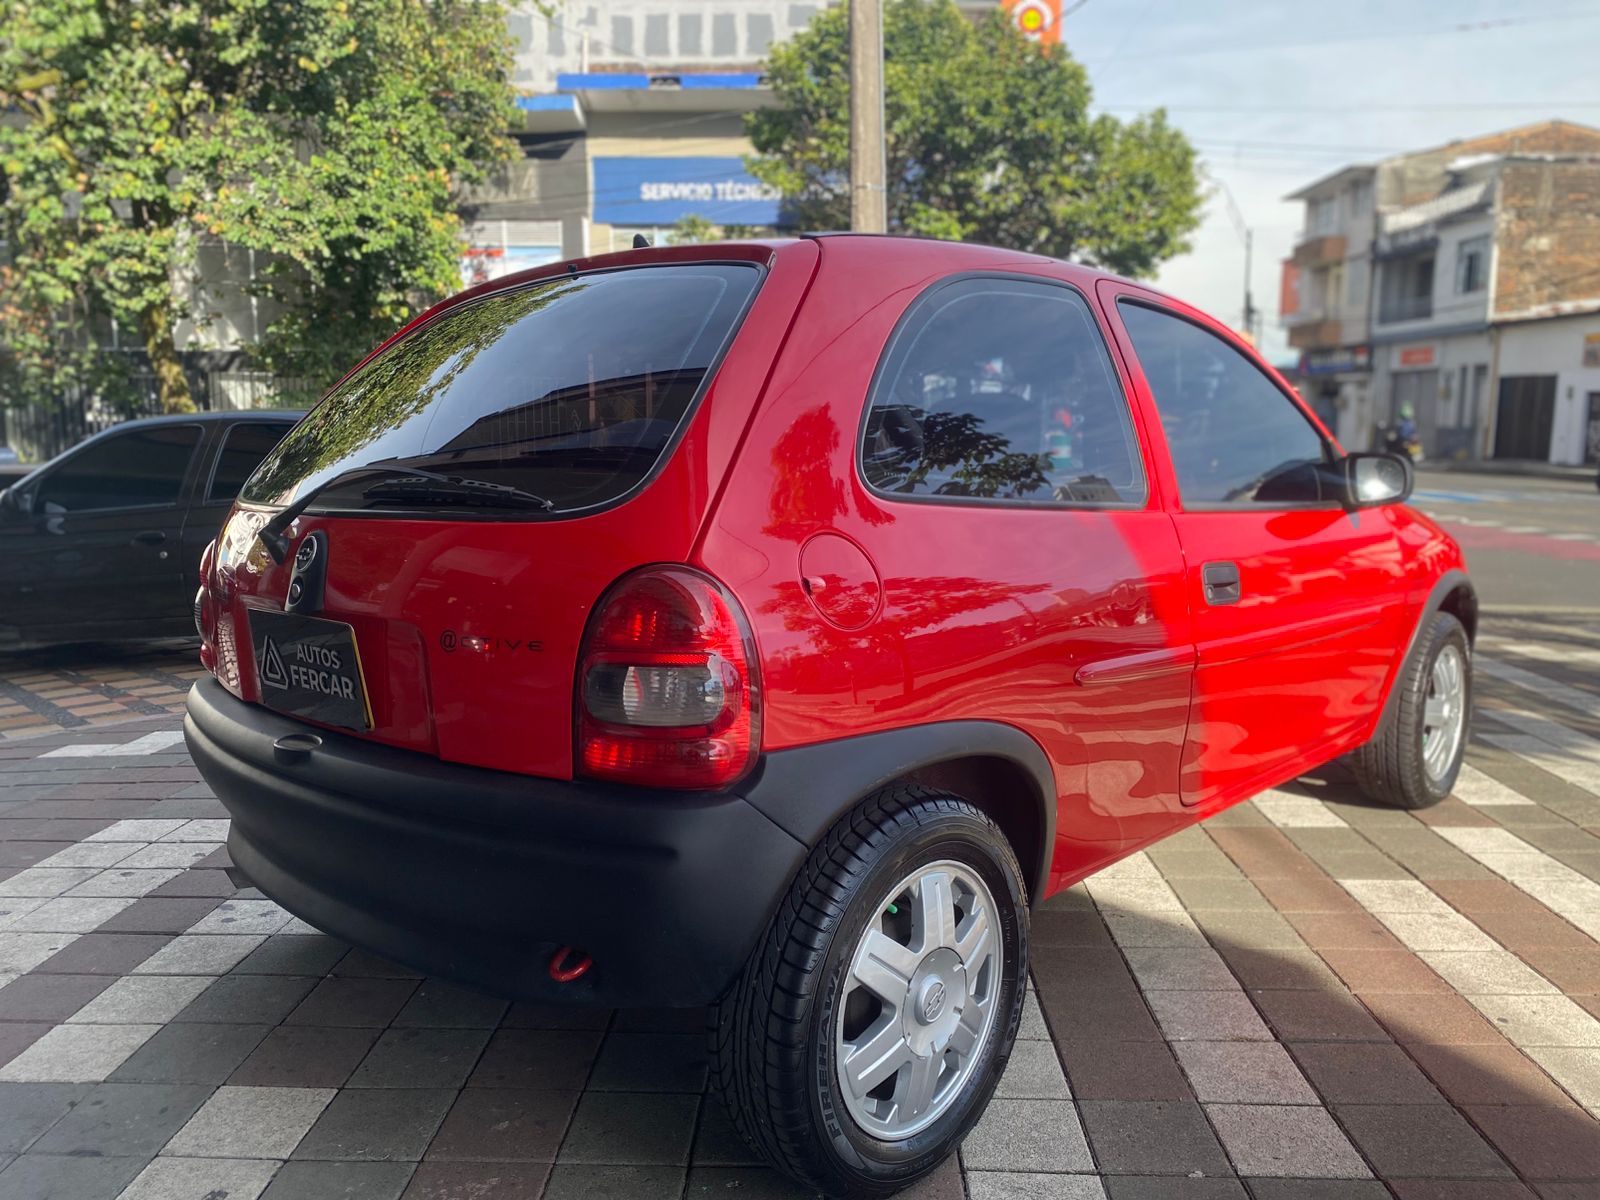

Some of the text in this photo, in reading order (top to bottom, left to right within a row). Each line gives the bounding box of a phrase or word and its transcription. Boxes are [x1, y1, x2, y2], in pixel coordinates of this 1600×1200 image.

[640, 182, 713, 201] SERVICIO
[297, 643, 341, 670] AUTOS
[289, 664, 355, 700] FERCAR
[817, 957, 845, 1140] FIREHAWK
